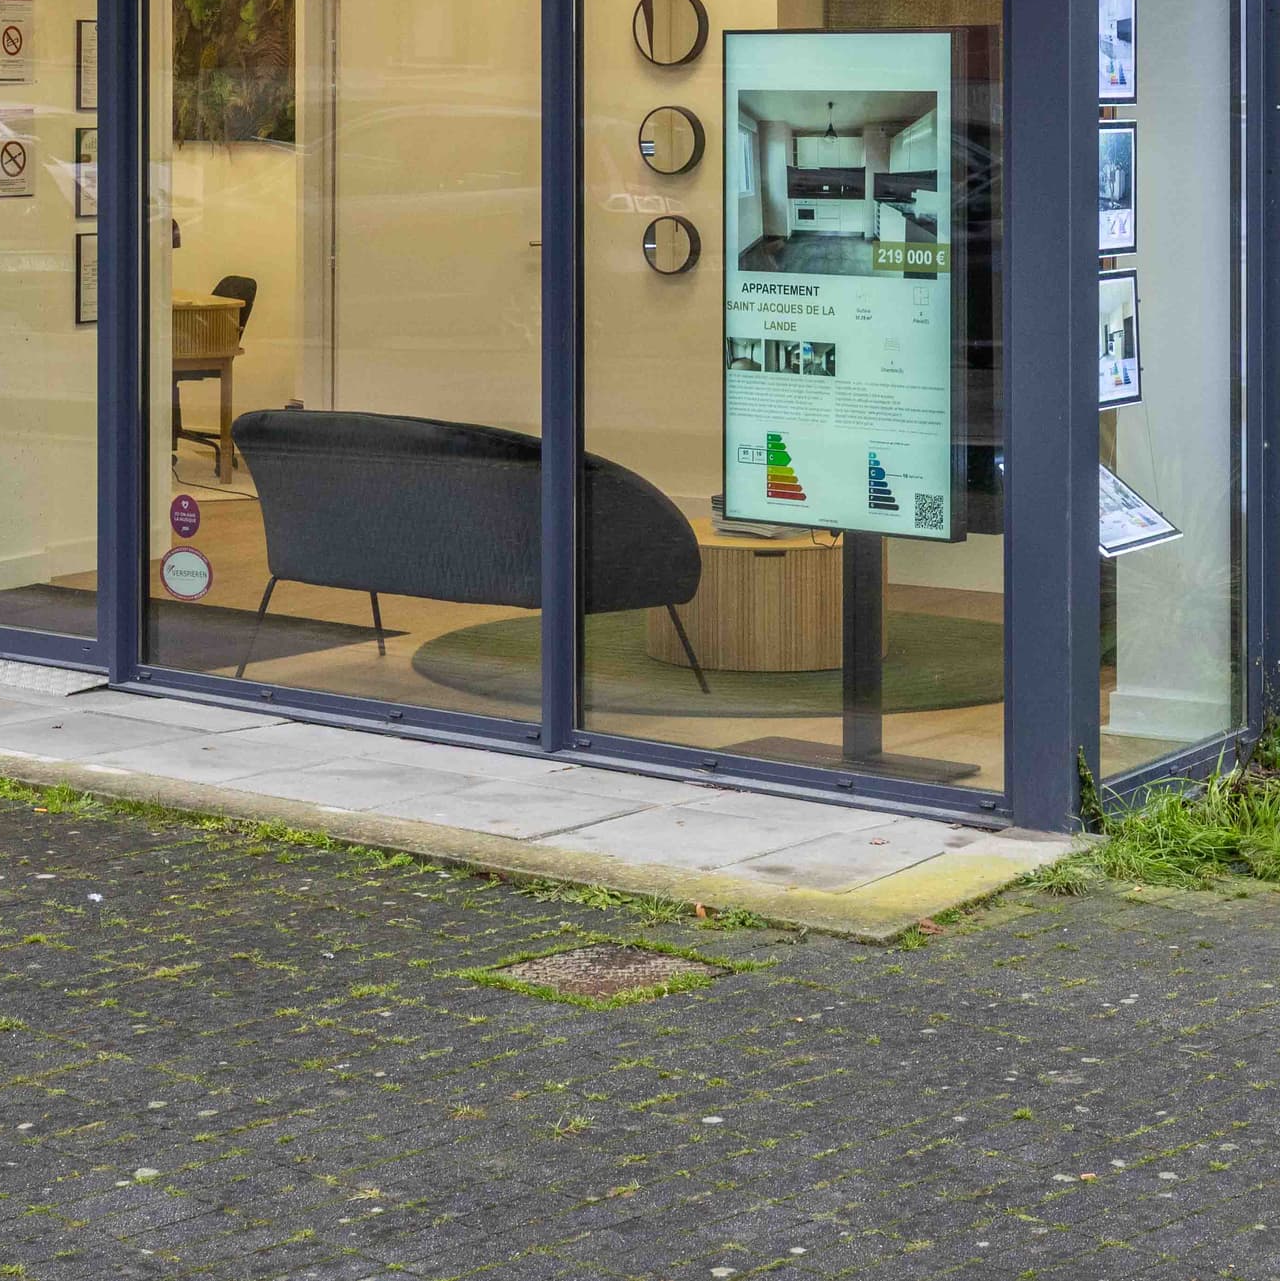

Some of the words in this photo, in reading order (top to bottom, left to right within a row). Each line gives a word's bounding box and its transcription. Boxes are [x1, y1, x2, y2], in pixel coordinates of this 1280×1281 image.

[878, 249, 903, 264] 219
[907, 249, 932, 265] 000
[936, 251, 945, 266] €
[741, 282, 820, 297] APPARTEMENT
[726, 300, 756, 313] SAINT
[757, 302, 803, 315] JACQUES
[806, 304, 820, 315] DE
[822, 304, 835, 316] LA
[764, 320, 797, 332] LANDE
